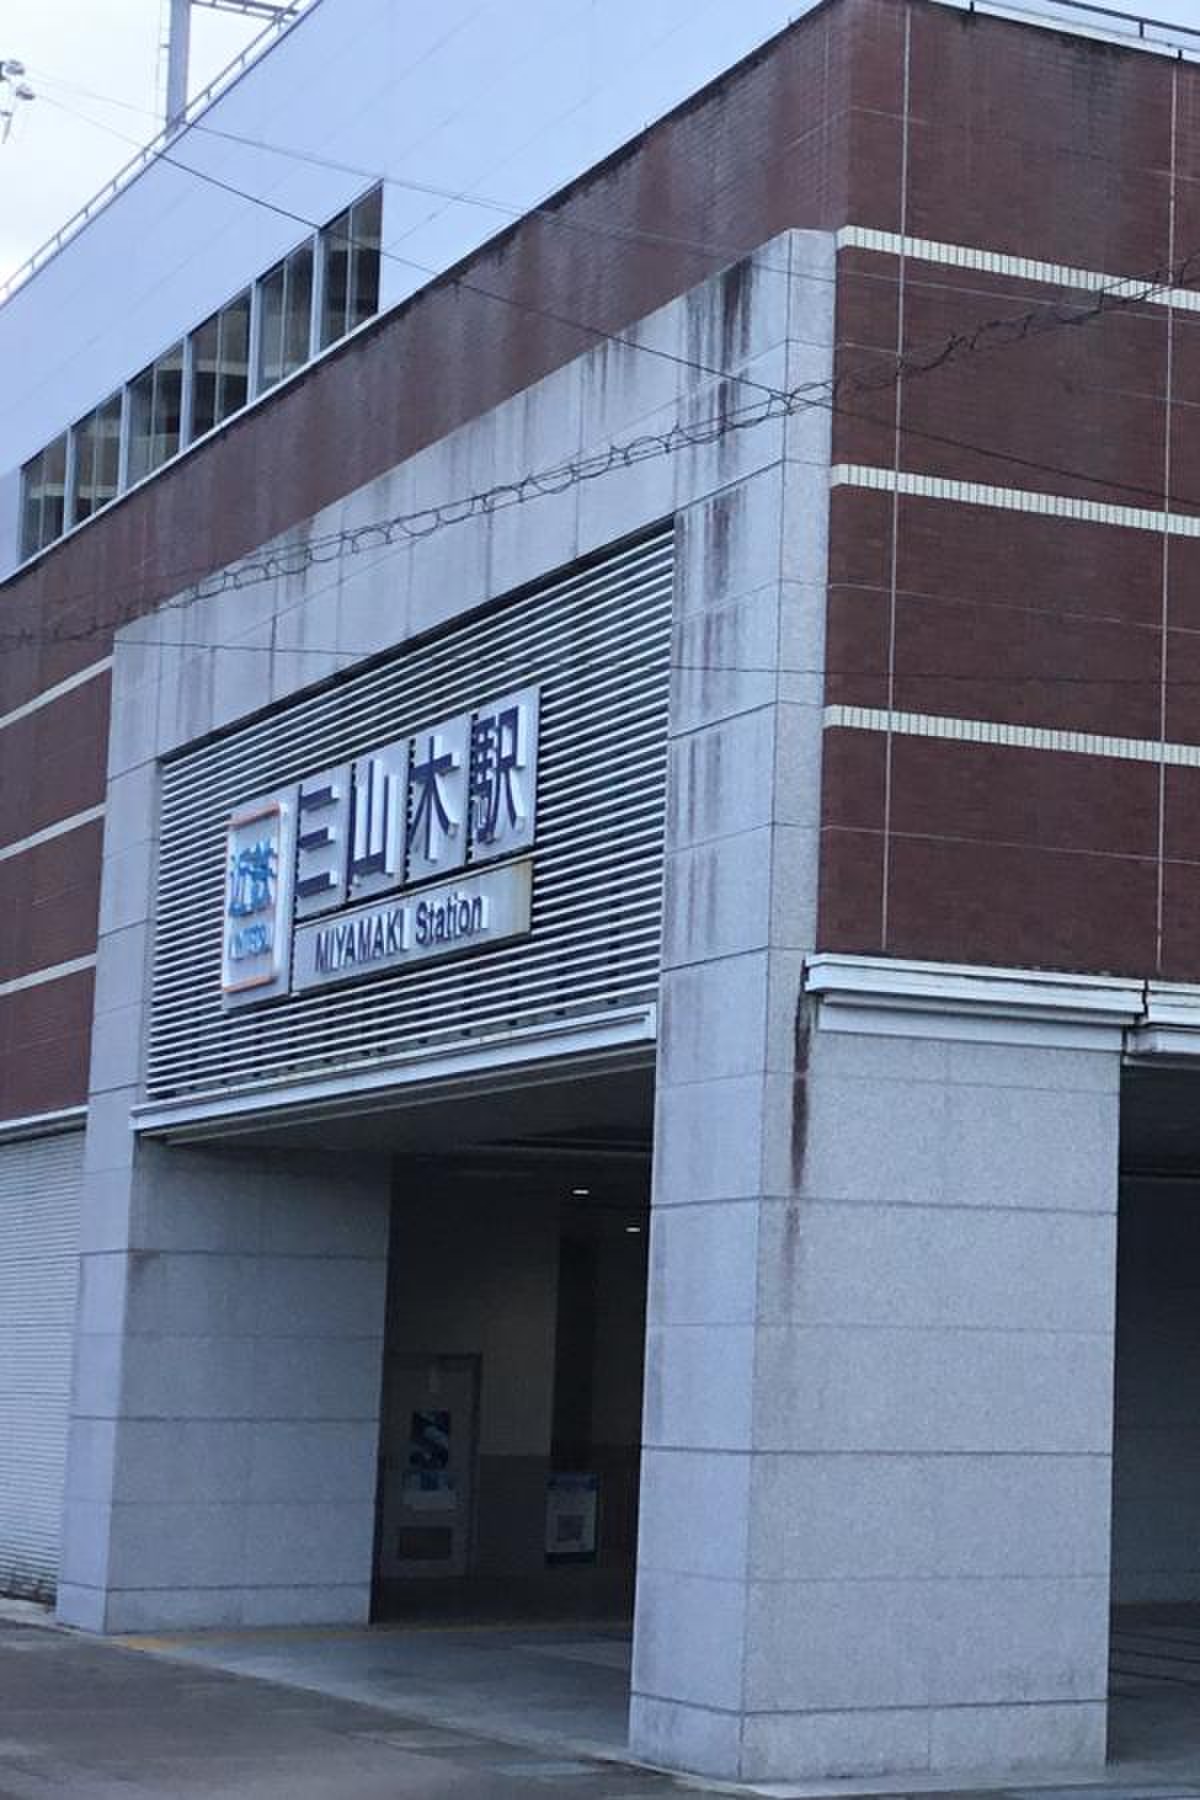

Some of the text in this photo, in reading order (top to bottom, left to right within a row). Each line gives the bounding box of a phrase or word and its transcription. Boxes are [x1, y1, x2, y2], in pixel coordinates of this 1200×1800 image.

[297, 704, 524, 898] 三山木駅
[315, 906, 405, 974] MIYAMAKI
[414, 893, 485, 947] Station
